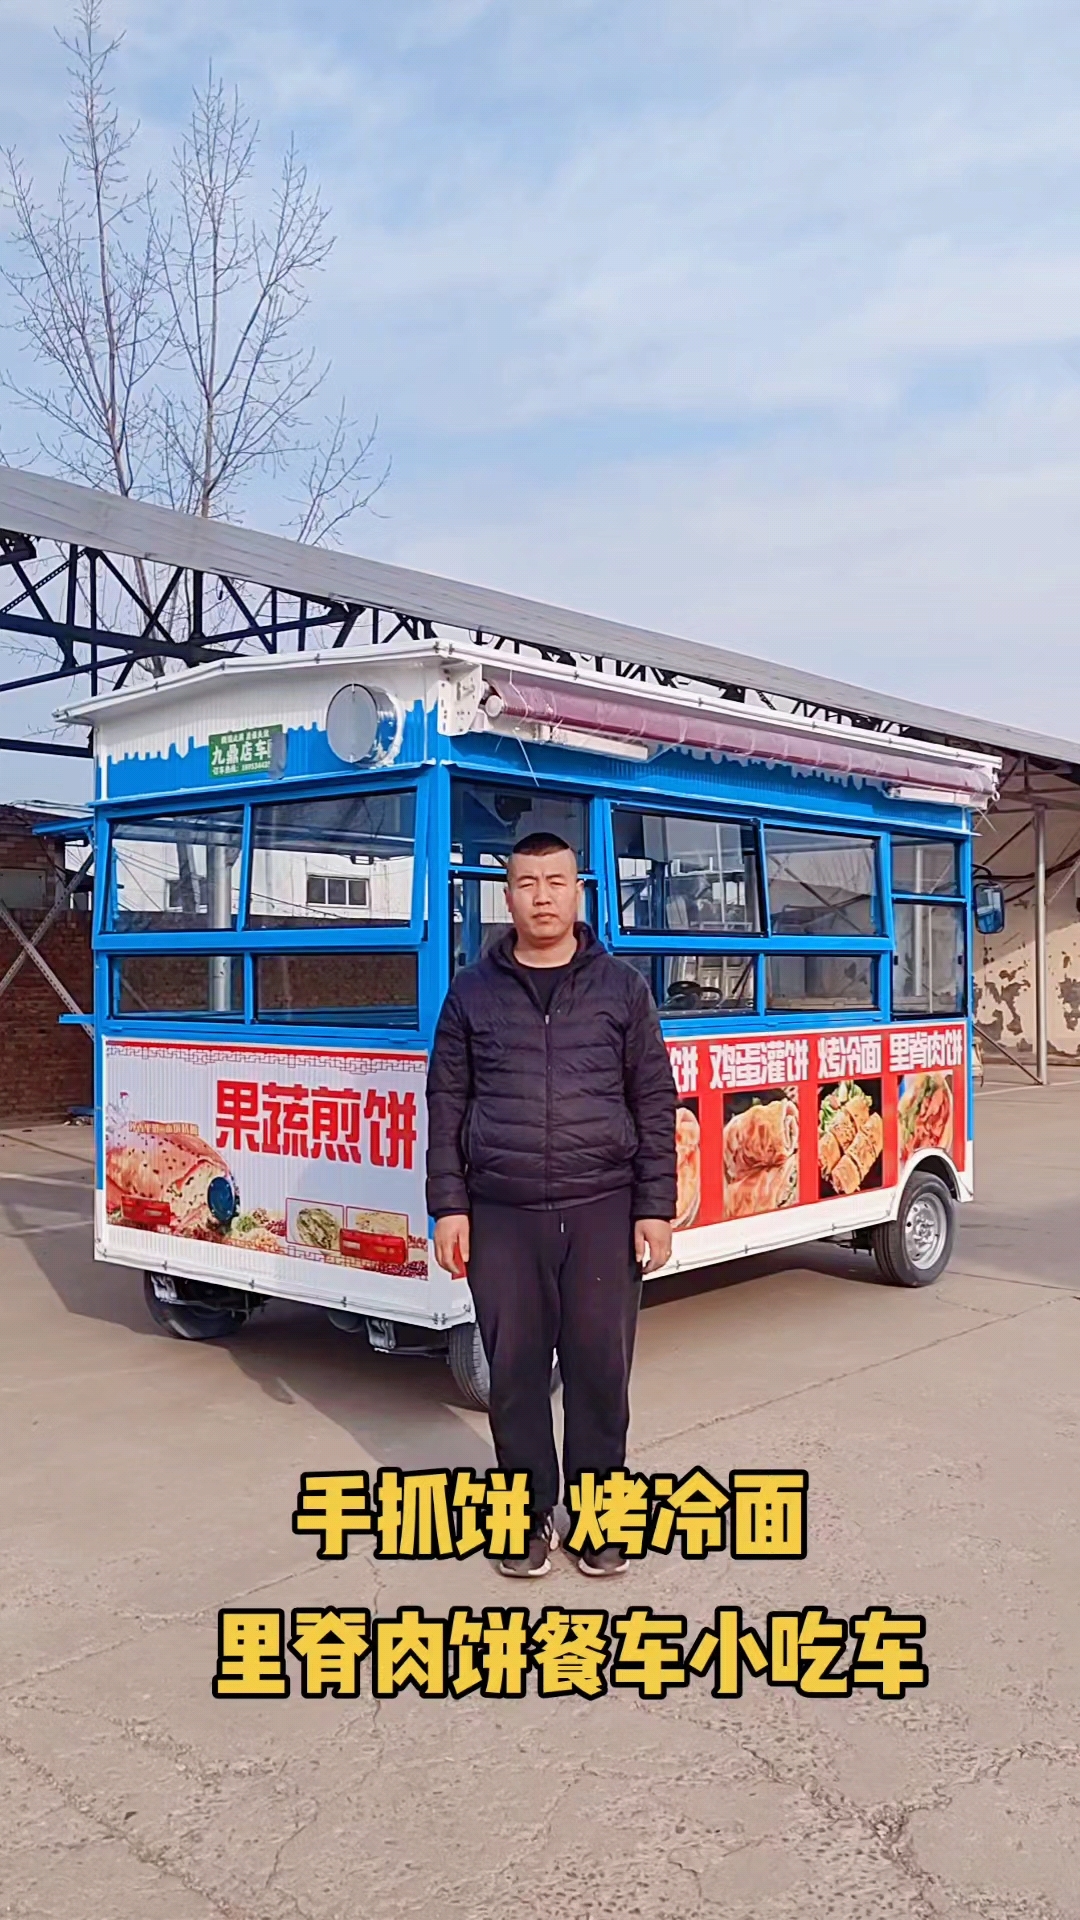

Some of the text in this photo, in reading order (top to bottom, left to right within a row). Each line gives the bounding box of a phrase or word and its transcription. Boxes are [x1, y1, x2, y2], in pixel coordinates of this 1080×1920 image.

[211, 739, 272, 766] 九鼎店车
[708, 1038, 810, 1090] 鸡蛋灌饼
[817, 1034, 882, 1079] 烤冷面
[889, 1029, 963, 1072] 里脊肉饼
[216, 1079, 416, 1169] 果蔬煎饼
